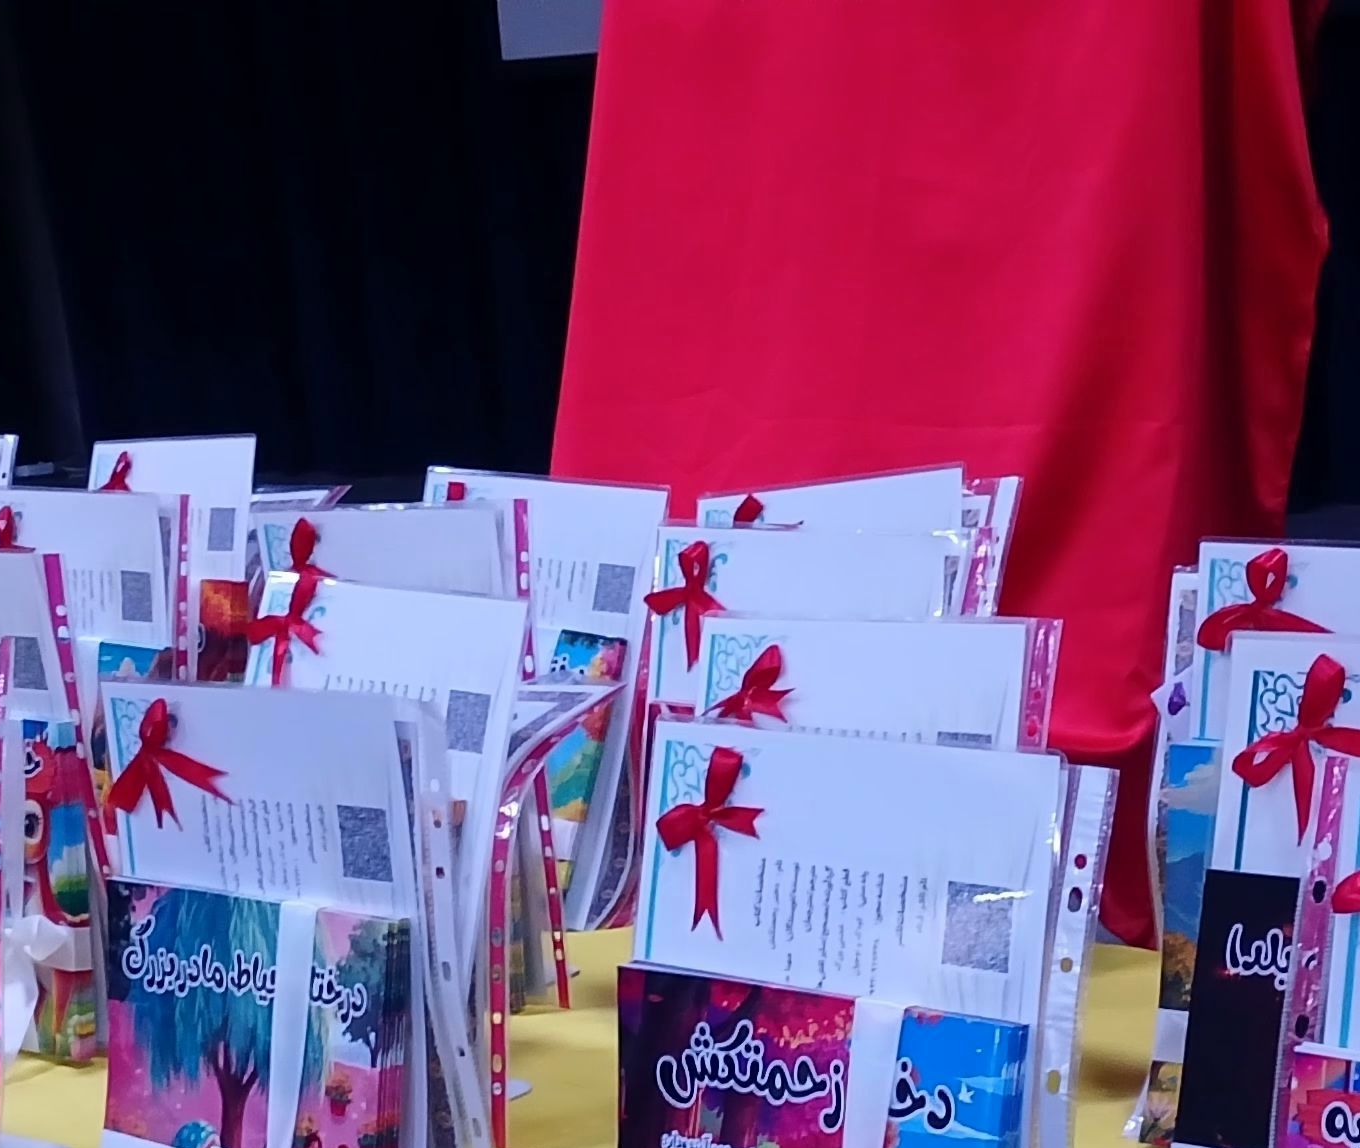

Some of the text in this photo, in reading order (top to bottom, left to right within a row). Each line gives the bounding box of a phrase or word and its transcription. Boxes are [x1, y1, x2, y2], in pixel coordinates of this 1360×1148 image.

[123, 917, 226, 995] مادربزرگ
[229, 951, 278, 1004] یاط
[658, 1020, 844, 1131] زحمتکش
